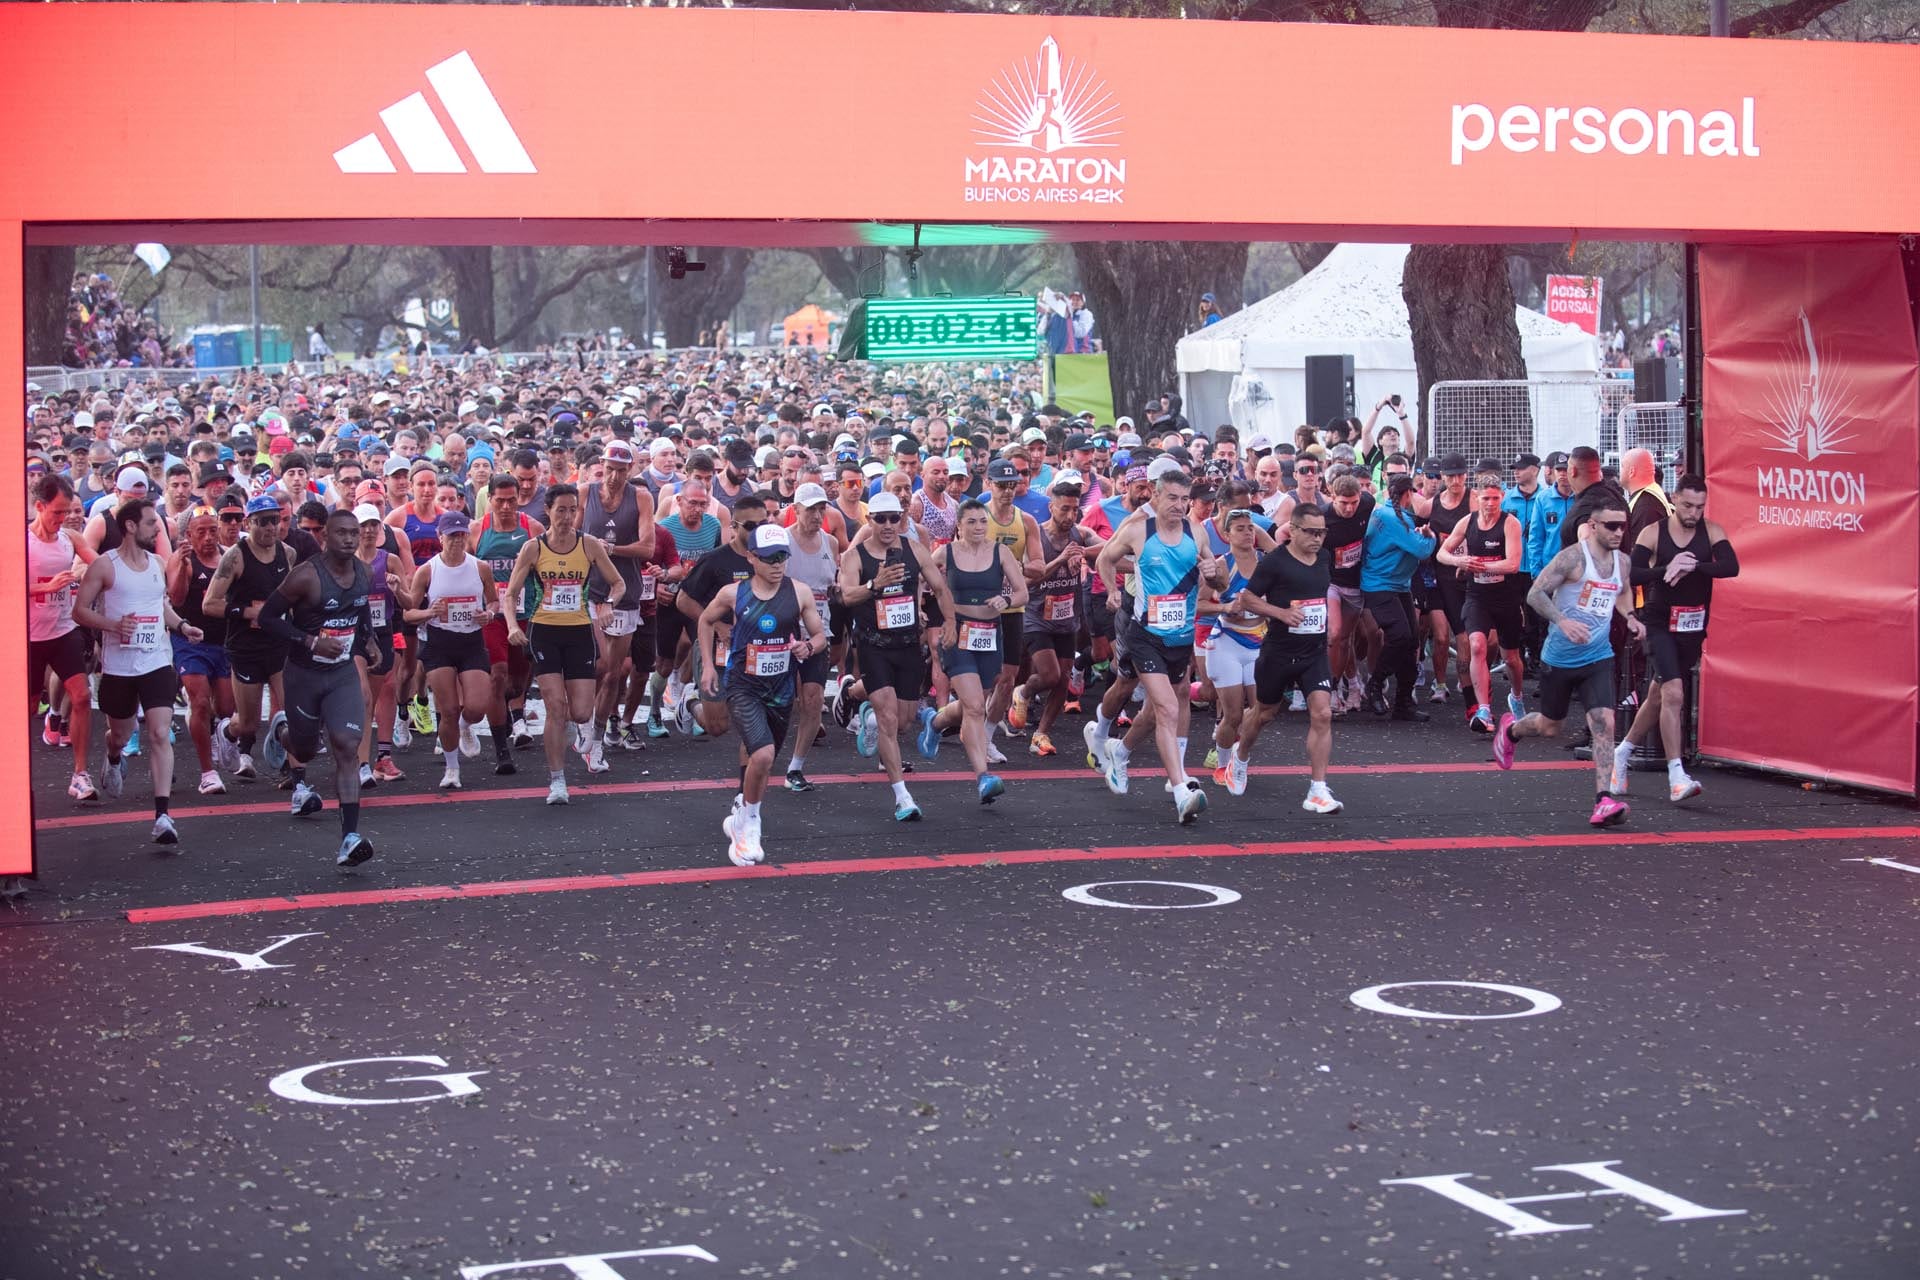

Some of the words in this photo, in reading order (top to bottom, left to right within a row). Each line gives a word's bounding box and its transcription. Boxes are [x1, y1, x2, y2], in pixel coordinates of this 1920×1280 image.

[1451, 97, 1760, 165] personal
[964, 157, 1126, 184] MARATON
[965, 187, 1030, 202] BUENOS
[1033, 188, 1078, 203] AIRES
[1079, 189, 1124, 203] 42K
[1551, 300, 1595, 314] DORSAL
[871, 313, 1031, 345] 00:02:45
[1757, 465, 1865, 505] MARATON
[1758, 505, 1801, 526] BUENOS
[1803, 509, 1832, 530] AIRES
[1832, 511, 1865, 532] 42K
[541, 570, 585, 580] BRASIL
[1040, 576, 1079, 590] personal
[555, 594, 577, 605] 3451
[452, 611, 473, 622] 5295
[891, 612, 911, 625] 3398
[1162, 610, 1183, 622] 5639
[1303, 615, 1323, 626] 5581
[136, 632, 155, 644] 1782
[971, 638, 992, 649] 4839
[761, 661, 785, 674] 5658
[1062, 880, 1242, 910] O
[131, 932, 324, 972] Y
[1349, 980, 1563, 1020] O
[268, 1055, 490, 1106] G
[1380, 1159, 1748, 1238] H
